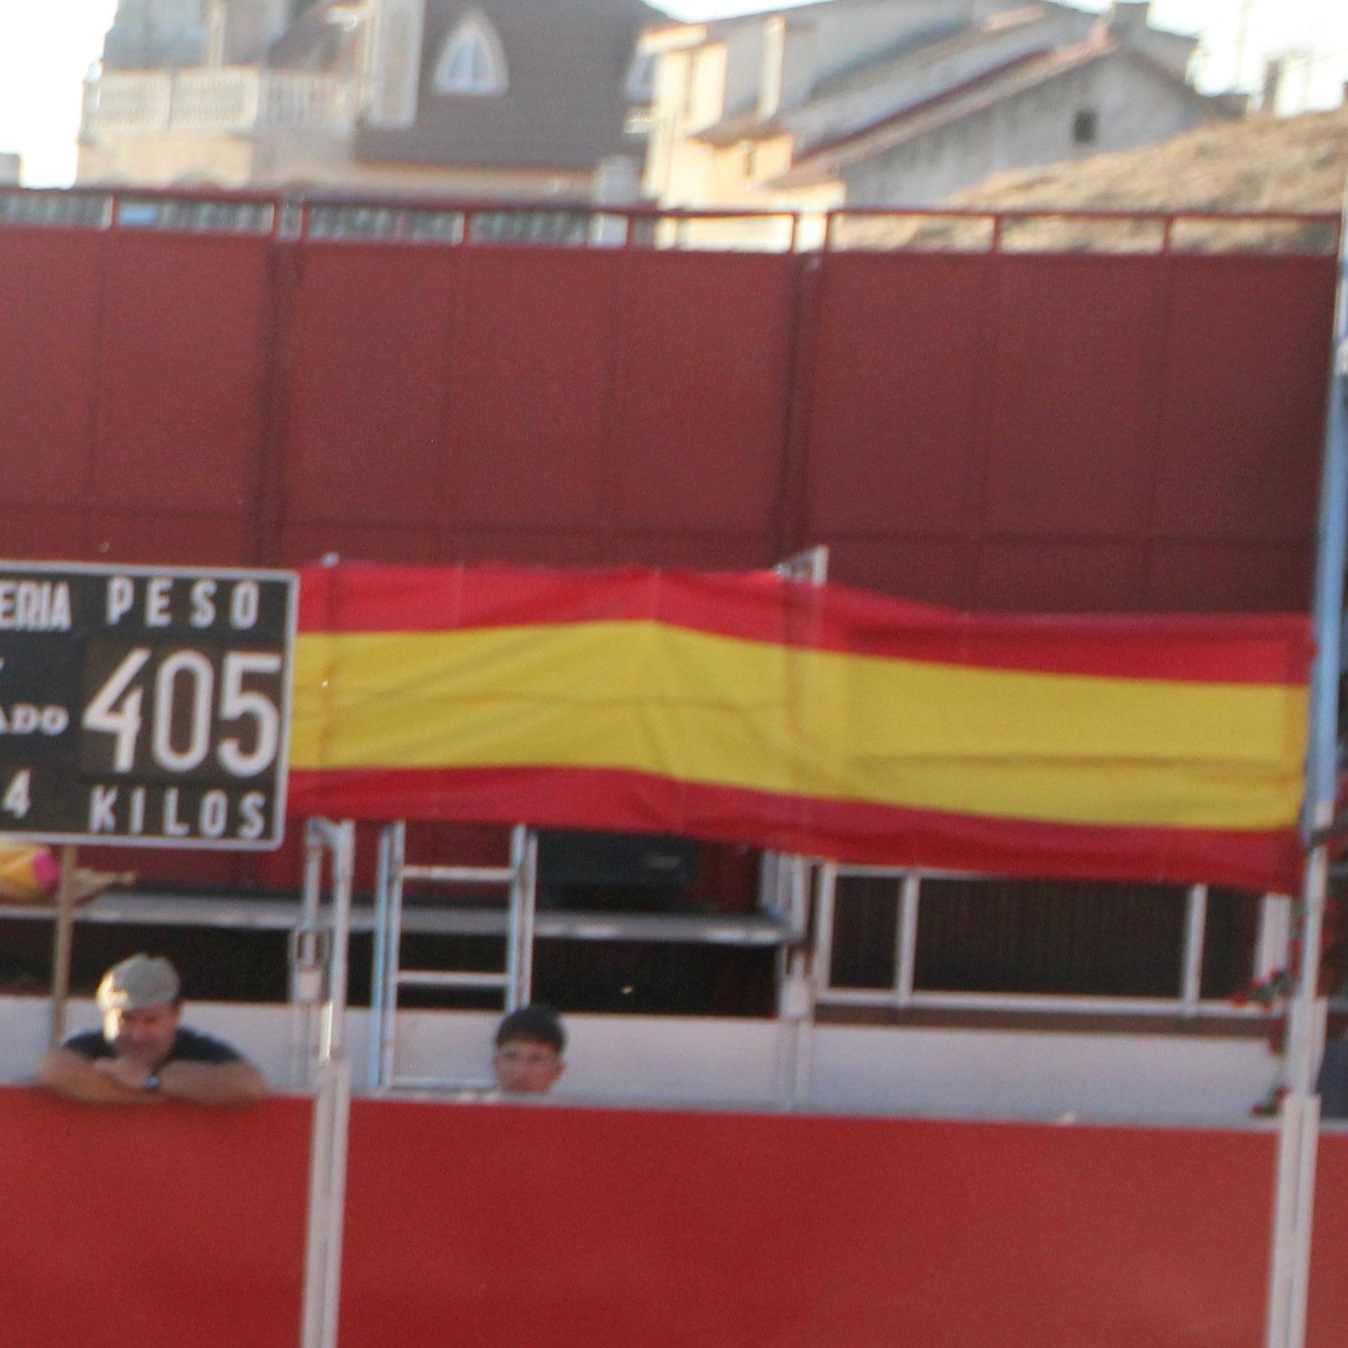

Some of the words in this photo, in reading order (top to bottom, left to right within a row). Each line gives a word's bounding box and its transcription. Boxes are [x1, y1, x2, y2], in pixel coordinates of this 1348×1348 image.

[106, 574, 260, 630] PESO
[82, 647, 284, 778] 405
[1, 768, 32, 819] 4
[89, 785, 266, 841] KILOS
